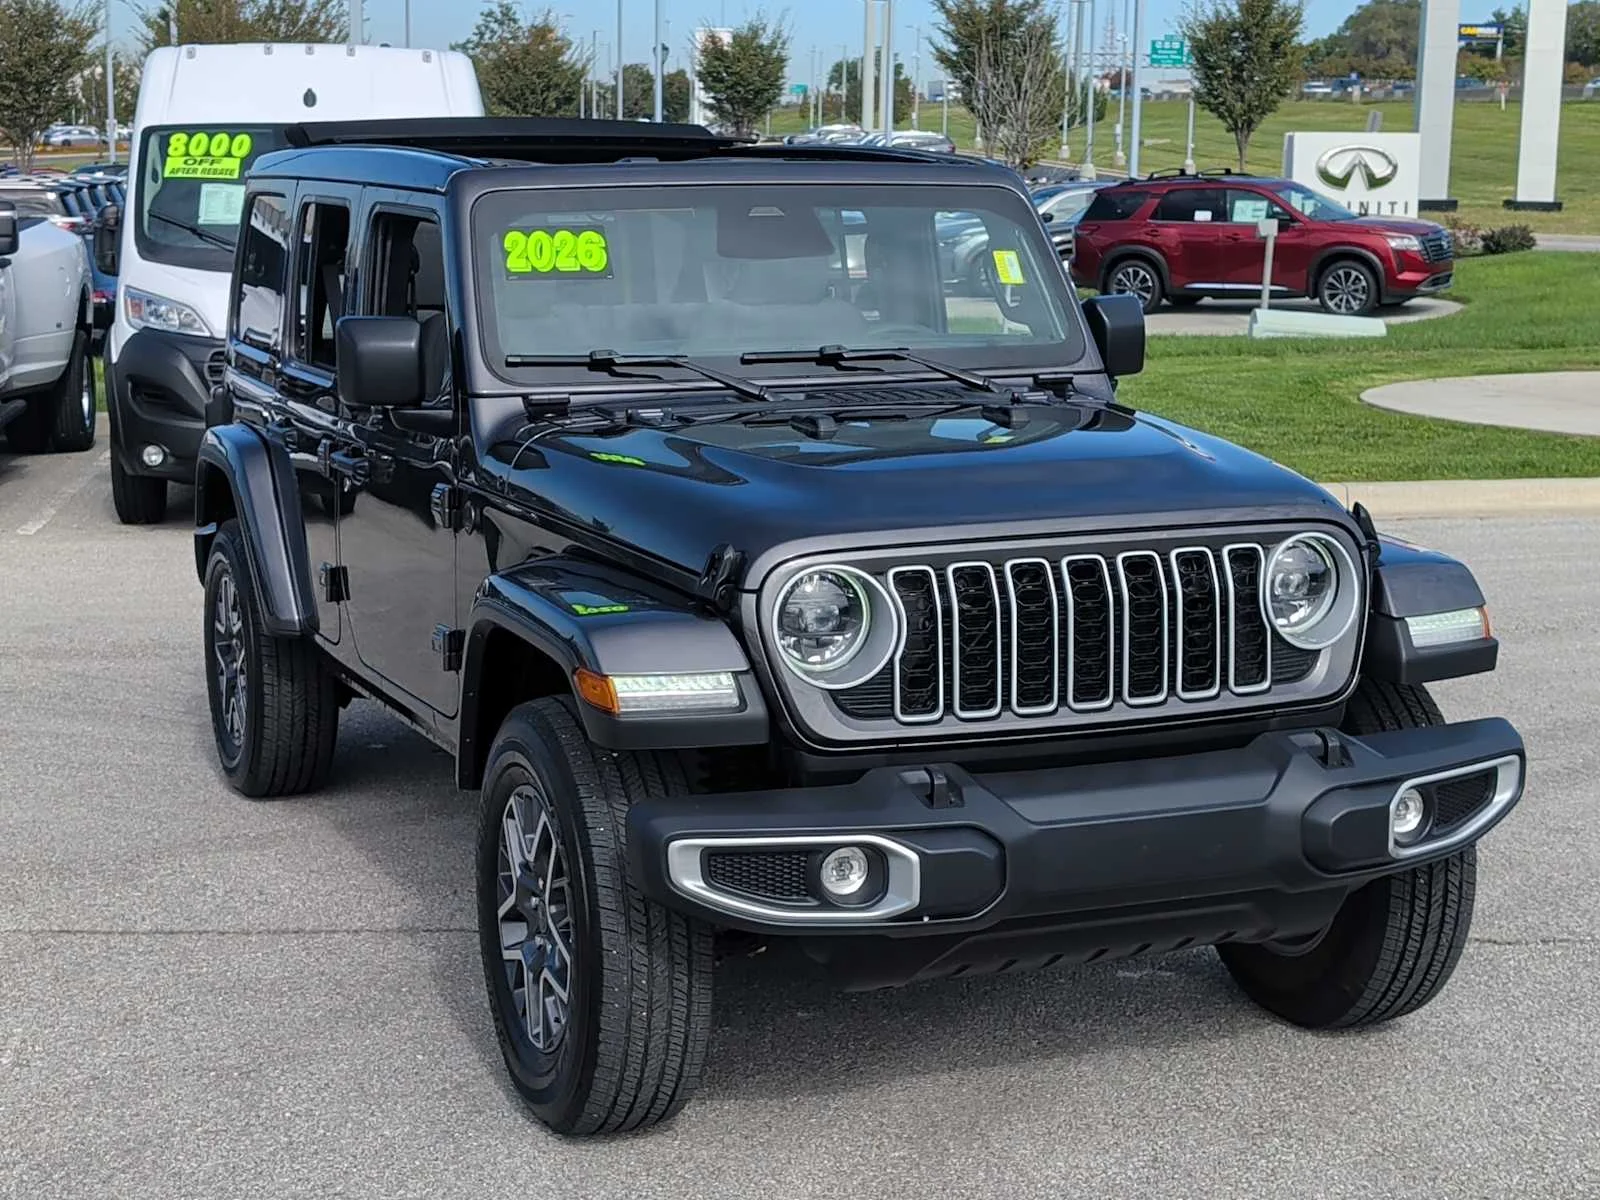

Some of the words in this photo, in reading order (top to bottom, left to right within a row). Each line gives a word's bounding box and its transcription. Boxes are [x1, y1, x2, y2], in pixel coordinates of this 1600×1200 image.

[168, 132, 252, 158] 8000
[183, 158, 223, 166] OFF
[169, 167, 198, 176] AFTER
[1347, 200, 1409, 217] INITI
[503, 230, 608, 273] 2026
